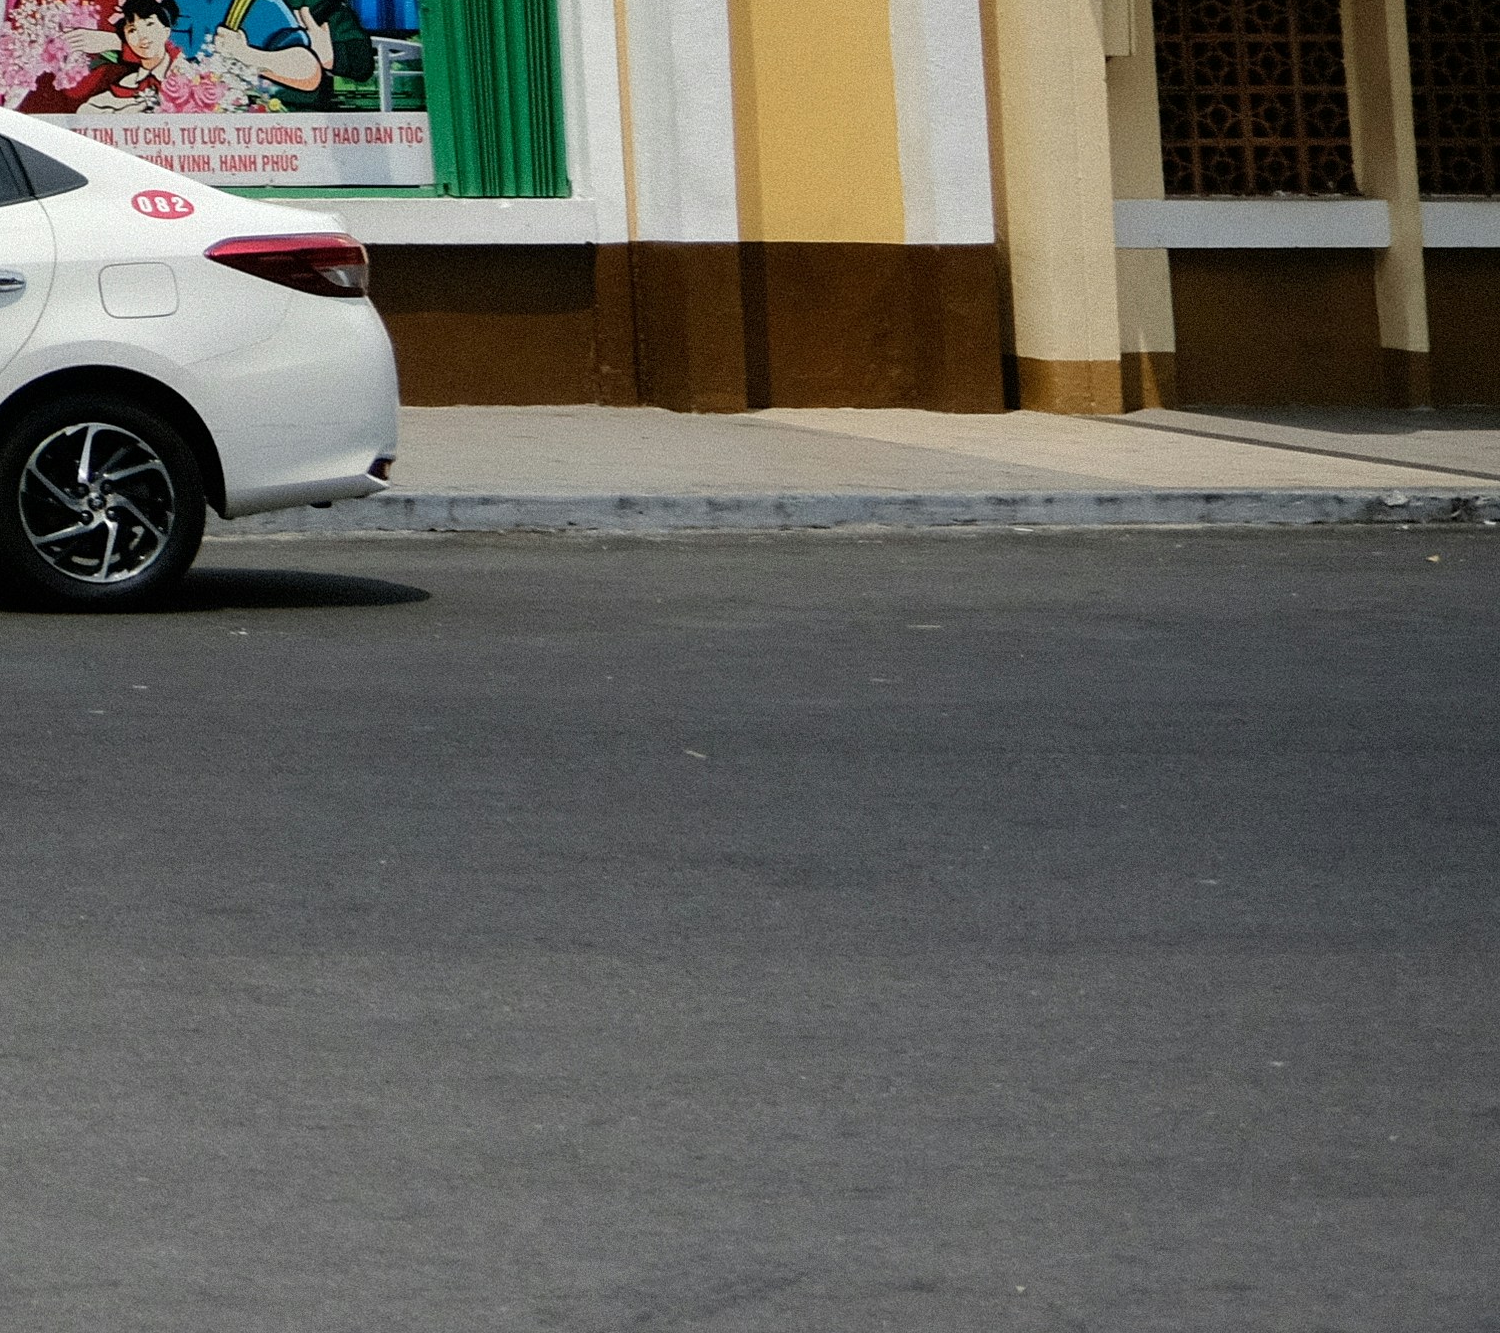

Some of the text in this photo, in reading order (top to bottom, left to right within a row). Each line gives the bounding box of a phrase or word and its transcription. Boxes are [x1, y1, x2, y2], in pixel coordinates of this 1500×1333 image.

[122, 127, 141, 149] TỰ
[180, 127, 199, 149] TỰ
[201, 126, 232, 149] LỰC,
[235, 126, 254, 149] TỰ
[311, 126, 329, 149] TỰ
[397, 123, 425, 149] TỘC
[178, 154, 216, 173] VINH,
[219, 154, 257, 175] HẠNH
[261, 151, 300, 172] PHÚC
[136, 194, 190, 214] 082
